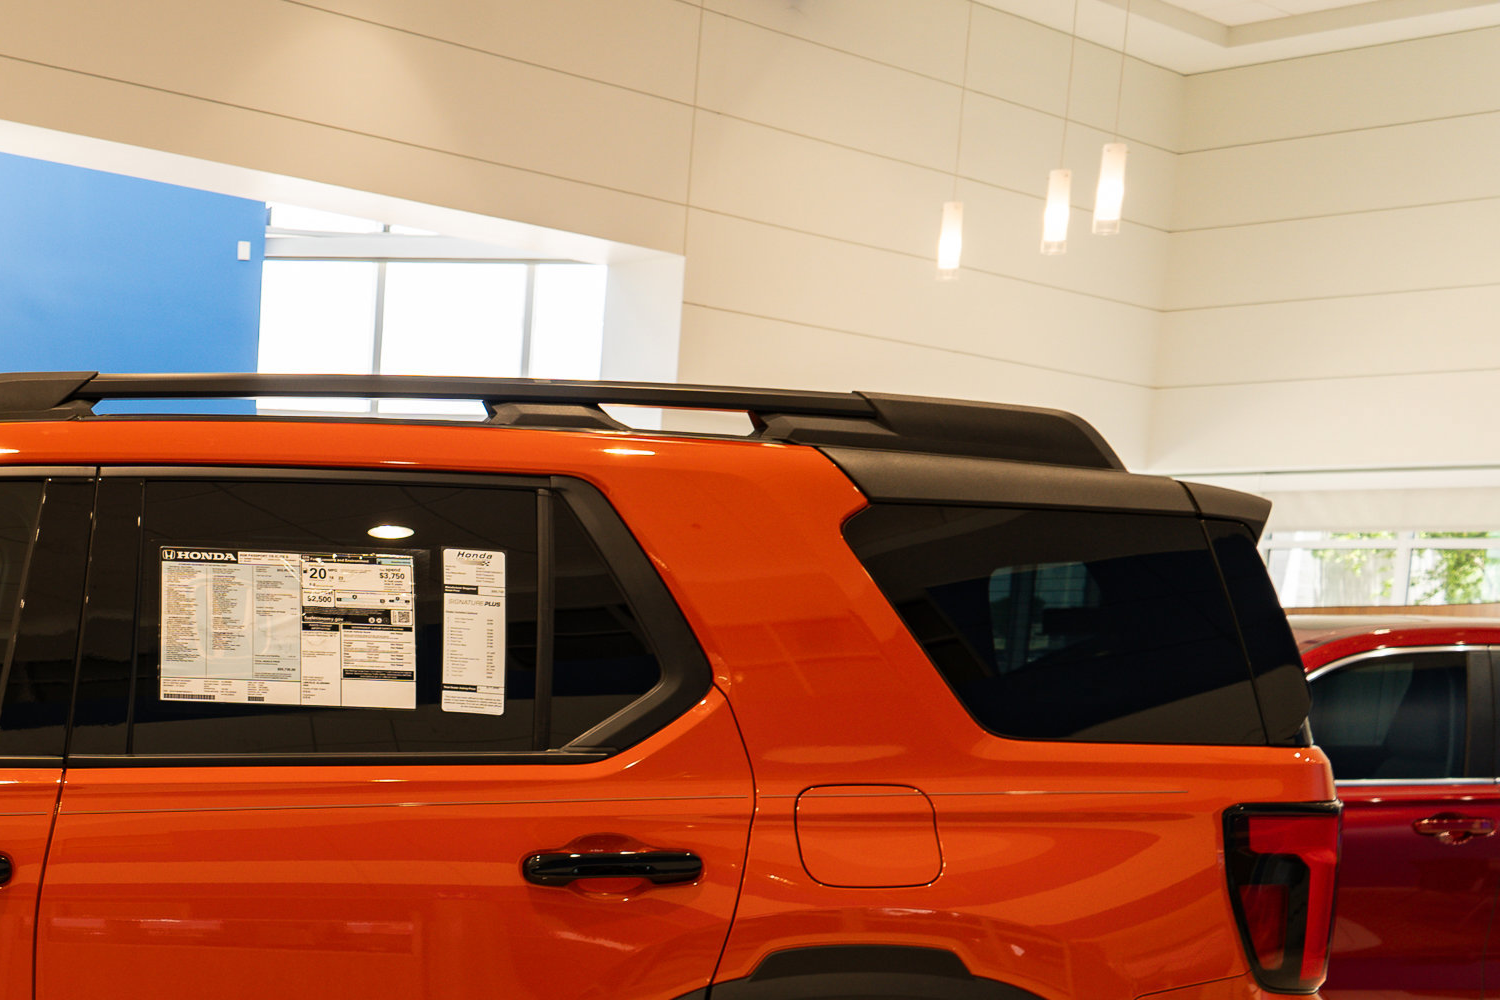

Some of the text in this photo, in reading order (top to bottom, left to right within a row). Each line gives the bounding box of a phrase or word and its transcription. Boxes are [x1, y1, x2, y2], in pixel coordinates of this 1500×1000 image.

[177, 551, 236, 561] HONDA
[457, 551, 493, 560] Honda
[309, 567, 327, 579] 20
[379, 572, 405, 580] $3,750
[307, 595, 332, 603] $2,500
